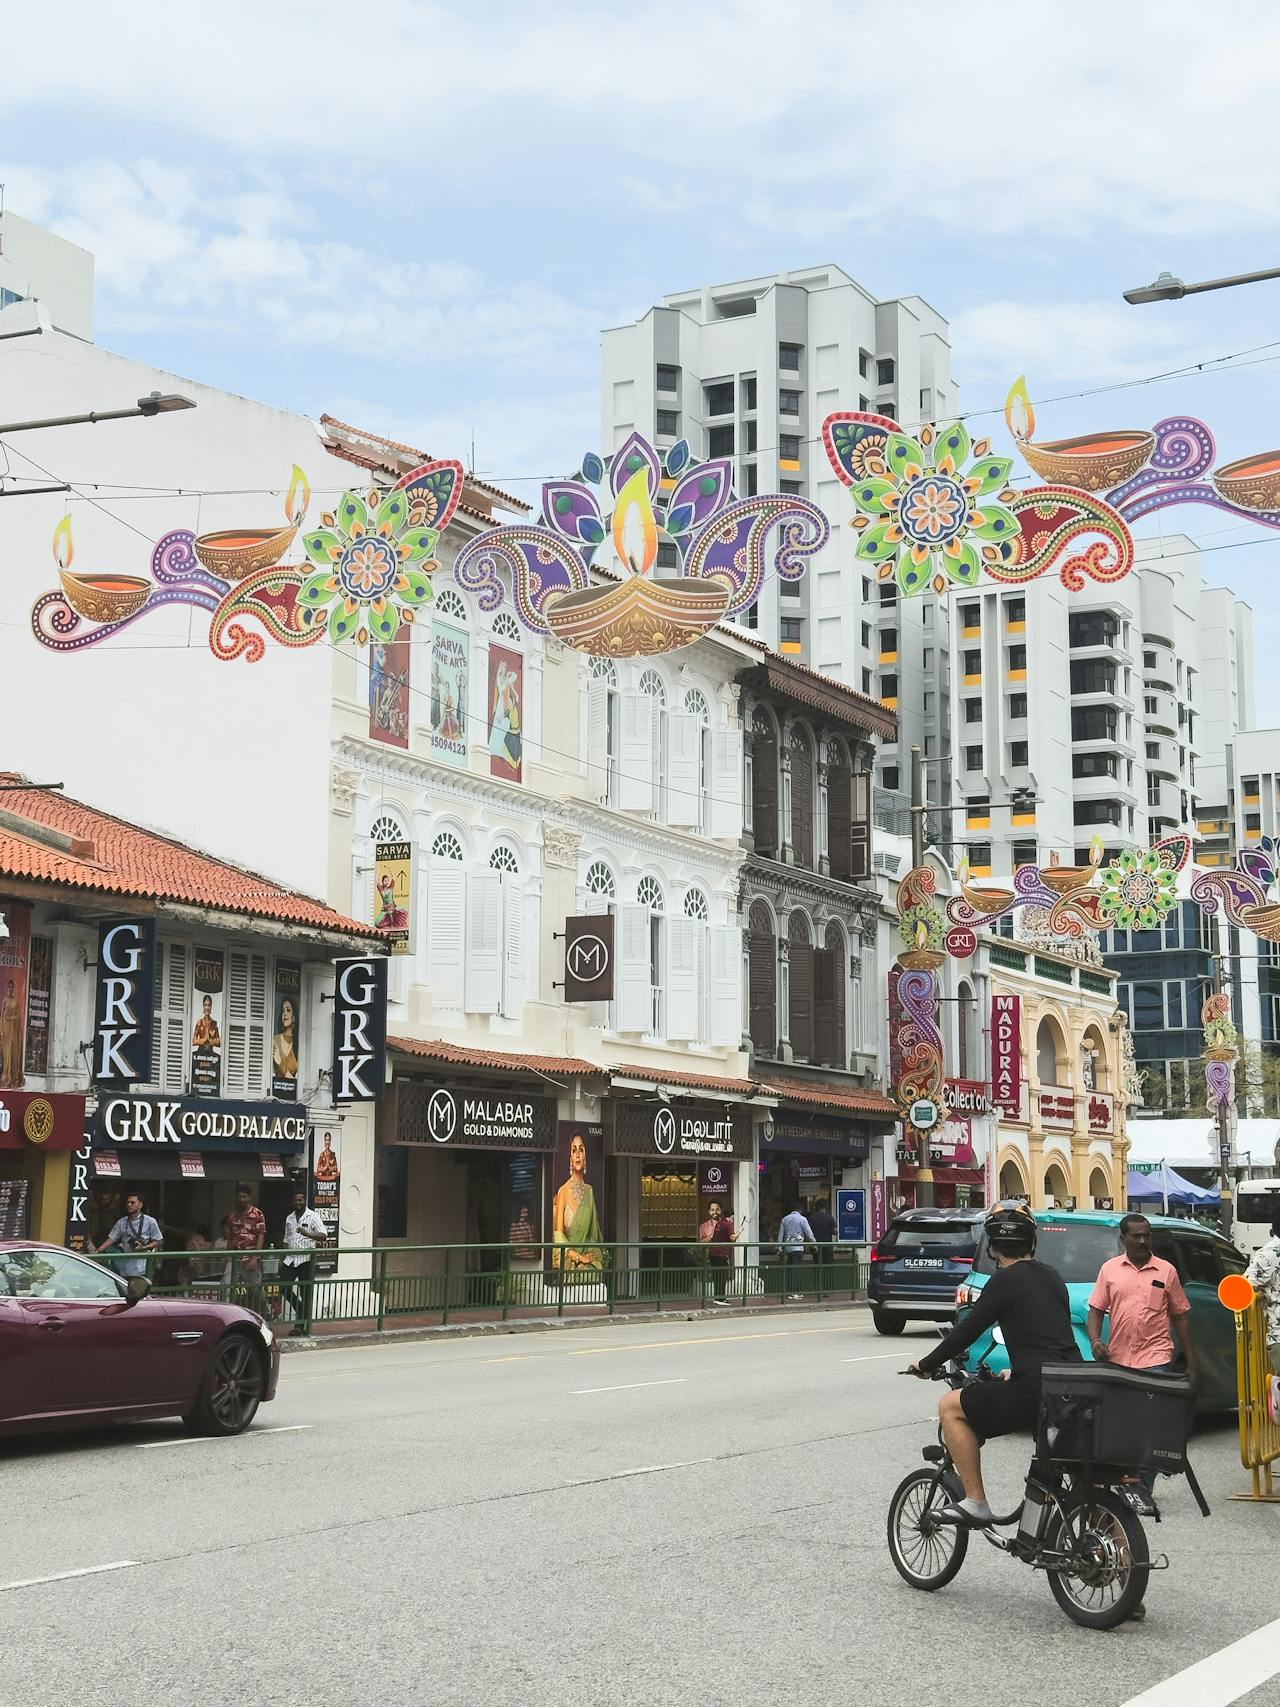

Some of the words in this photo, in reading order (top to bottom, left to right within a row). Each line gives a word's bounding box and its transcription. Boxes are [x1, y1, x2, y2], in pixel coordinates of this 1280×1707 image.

[435, 635, 465, 657] SARVA
[432, 646, 448, 665] FINE
[449, 655, 467, 668] ARTS
[376, 845, 410, 856] SARVA
[948, 934, 972, 948] GRT
[196, 963, 222, 981] GRK
[277, 971, 299, 988] GRK
[97, 924, 142, 1078] GRK
[337, 963, 375, 1098] GRK
[997, 997, 1013, 1099] MADURAS
[105, 1100, 181, 1143] GRK
[182, 1112, 236, 1136] GOLD
[239, 1115, 305, 1140] PALACE
[464, 1100, 533, 1124] MALABAR
[464, 1124, 486, 1135] GOLD
[487, 1125, 492, 1136] &
[493, 1126, 533, 1139] DIAMONDS
[681, 1115, 733, 1139] மலபார்
[897, 1151, 941, 1160] TATO
[317, 1182, 337, 1191] TODAY'S
[904, 1259, 943, 1267] SLC6799G
